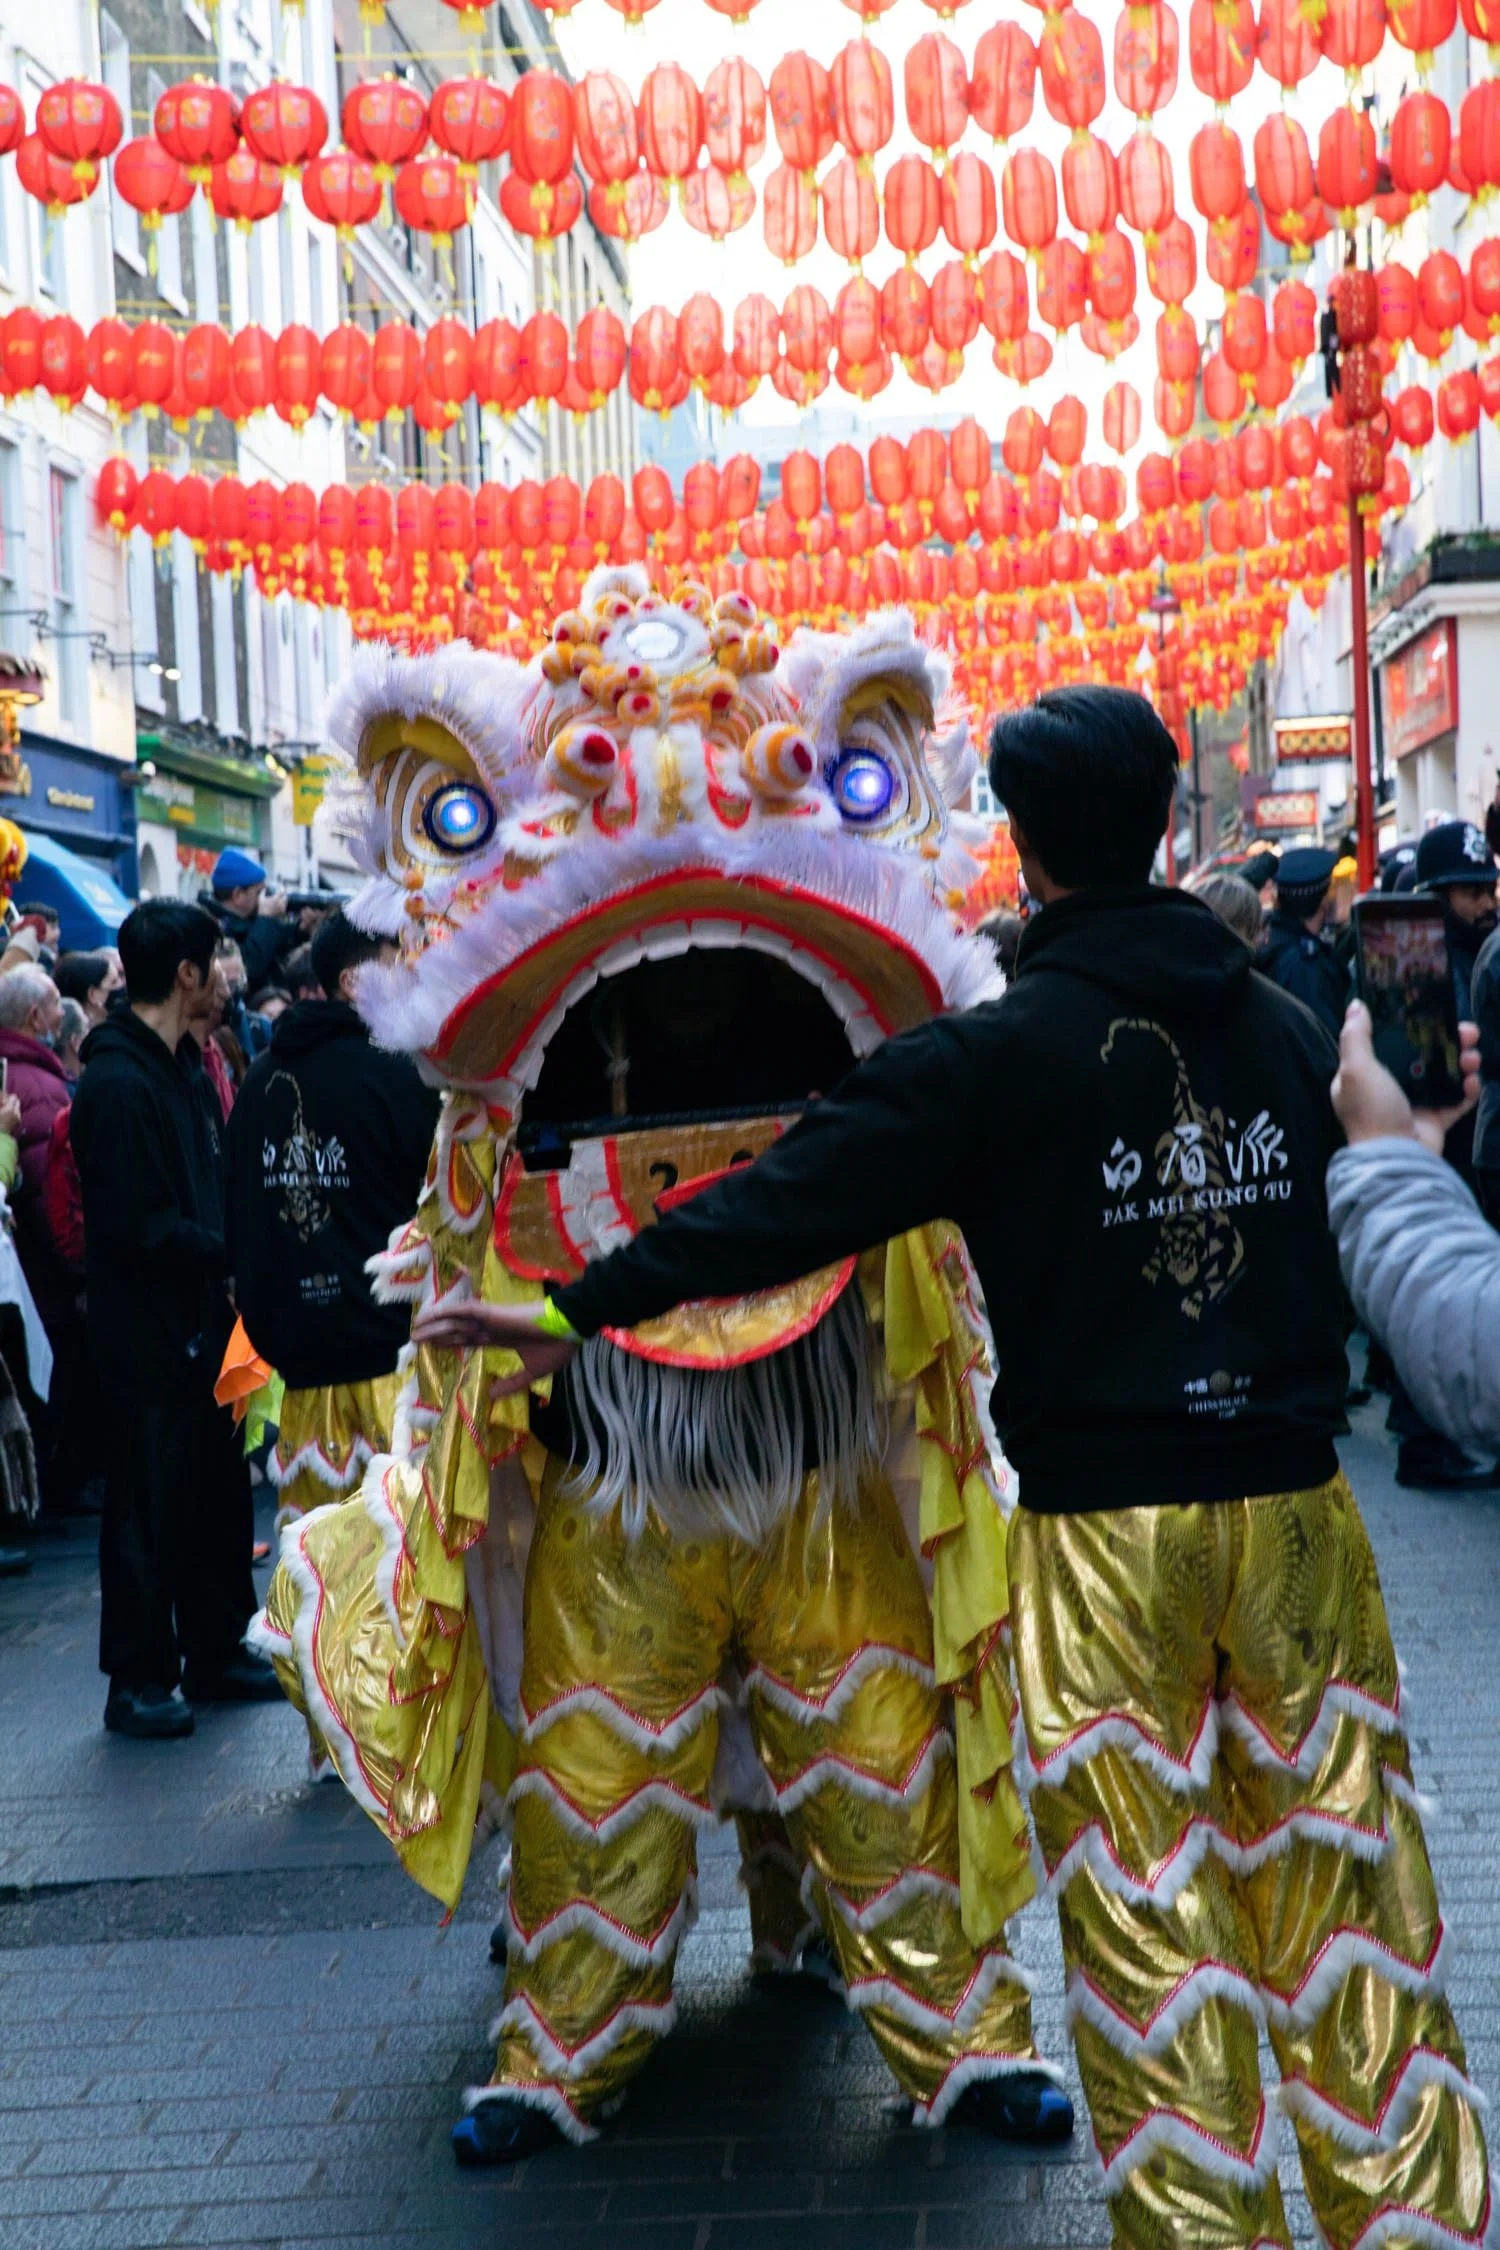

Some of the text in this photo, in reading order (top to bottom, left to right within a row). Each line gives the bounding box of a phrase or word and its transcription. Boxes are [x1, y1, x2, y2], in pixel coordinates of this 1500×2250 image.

[1102, 1201, 1140, 1228] PAK
[1147, 1192, 1186, 1219] MEI
[1194, 1183, 1258, 1212] KUNG
